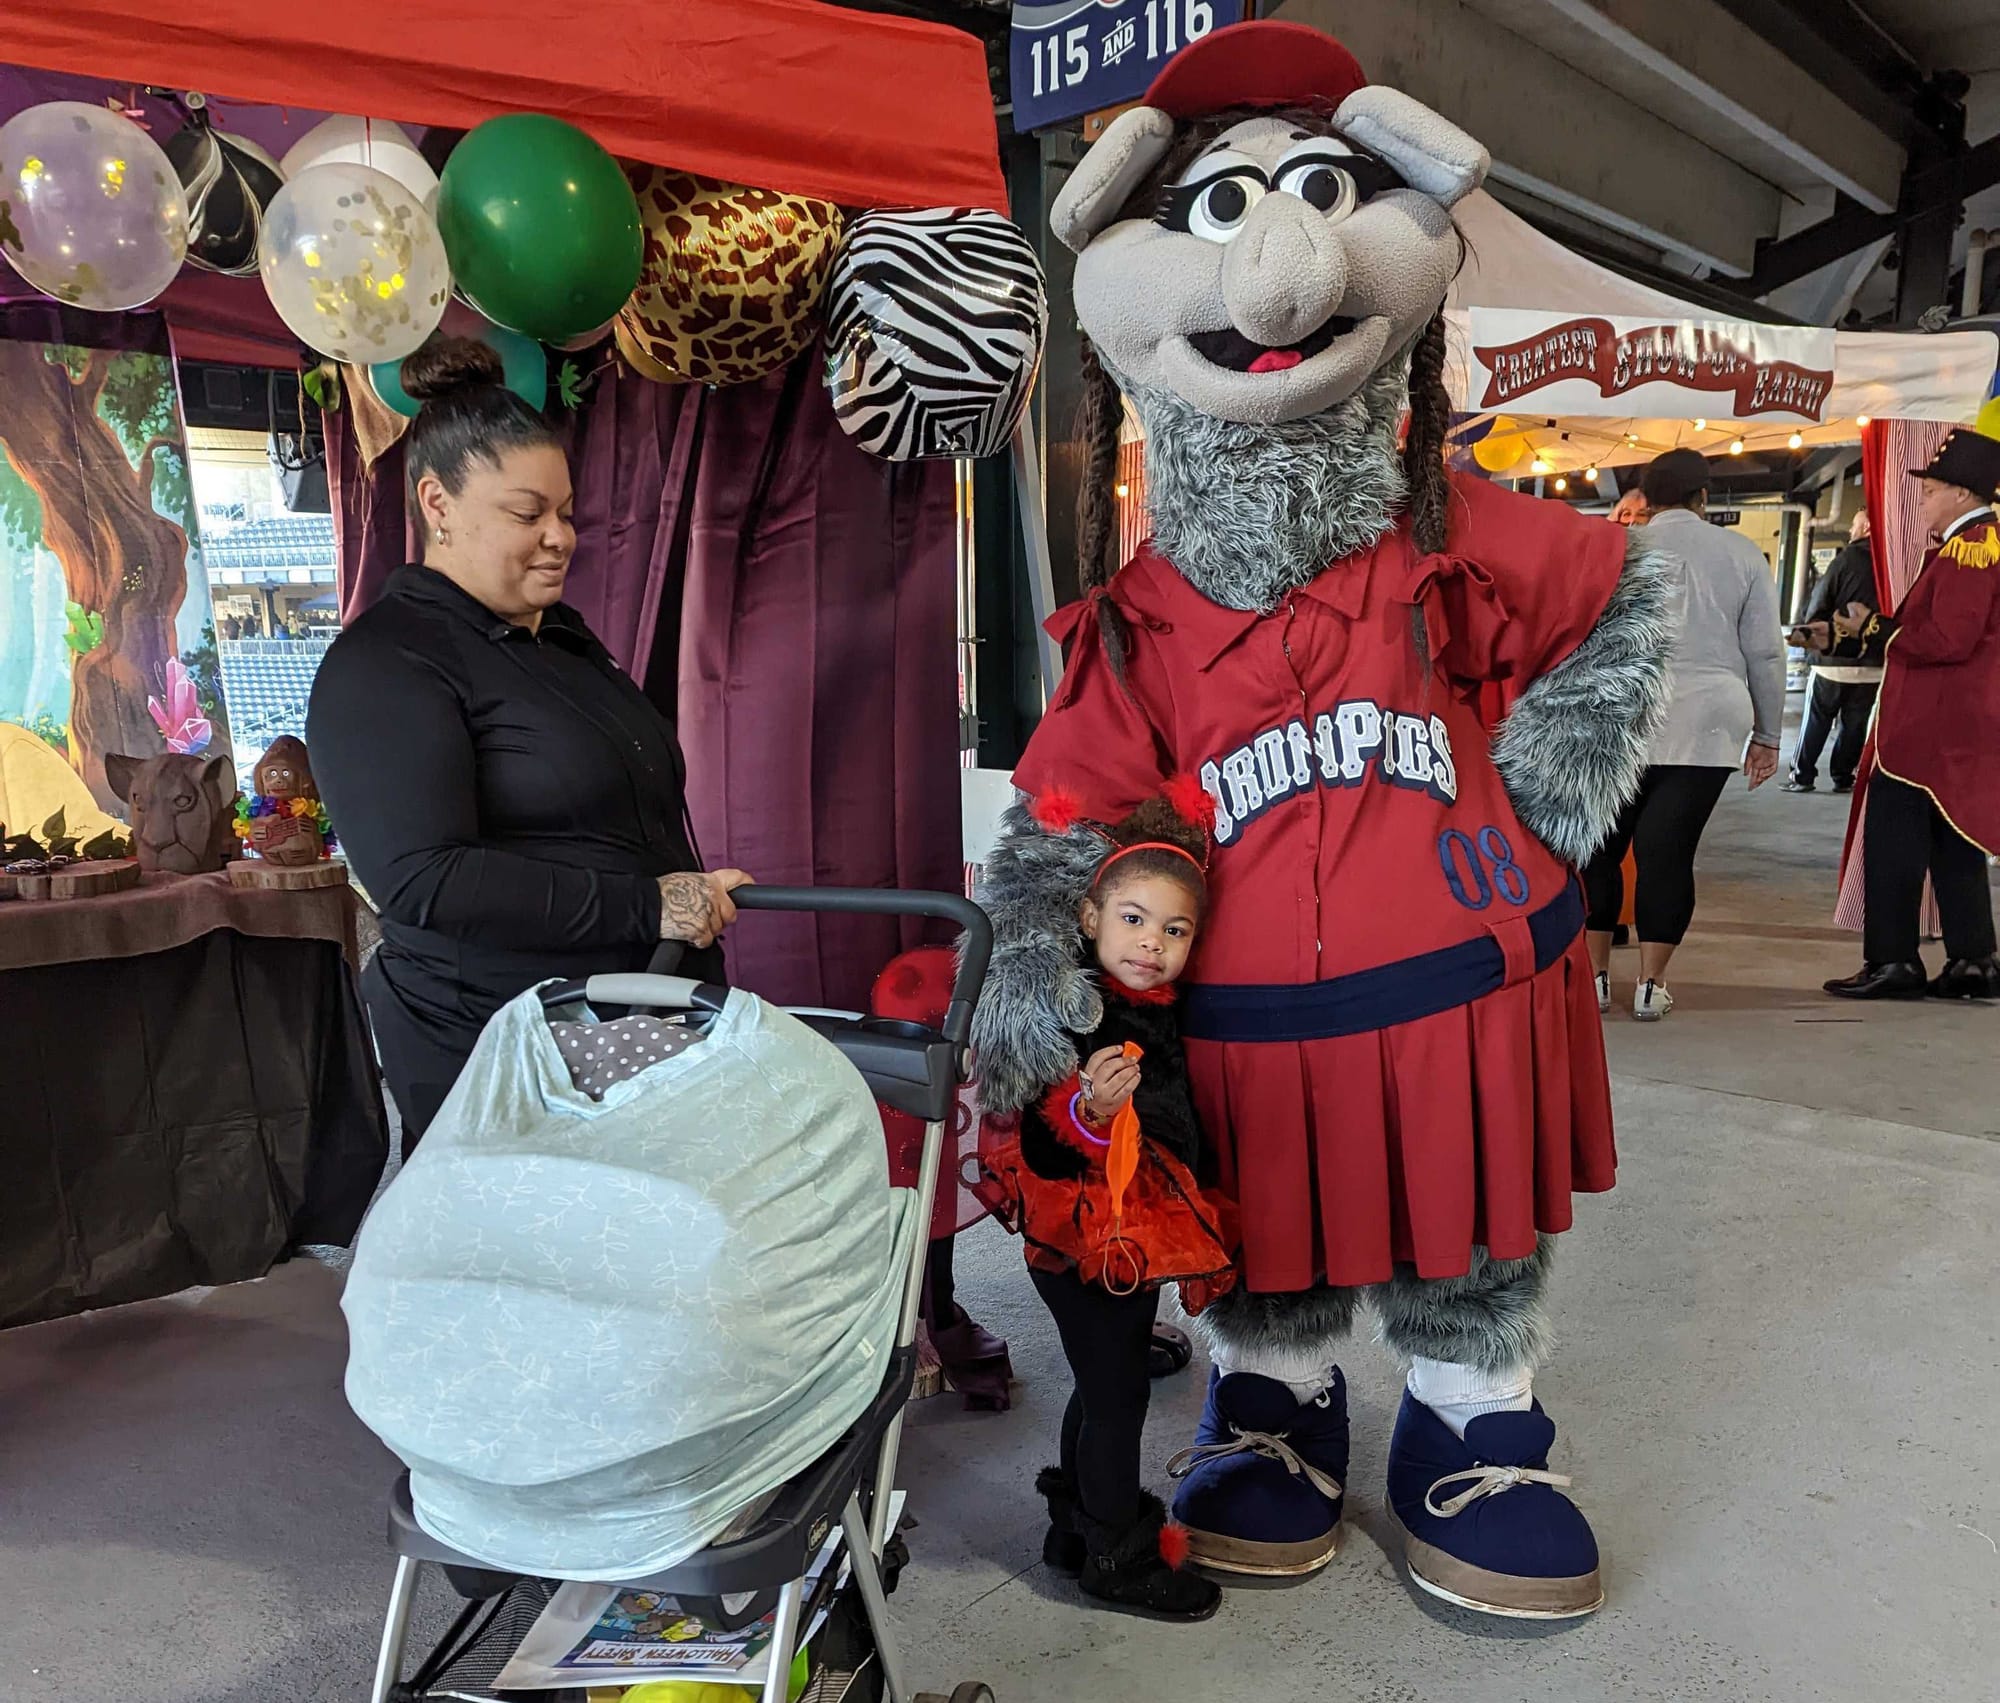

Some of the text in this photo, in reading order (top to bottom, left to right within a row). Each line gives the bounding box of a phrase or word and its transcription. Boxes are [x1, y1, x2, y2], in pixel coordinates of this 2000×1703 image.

[1031, 0, 1214, 97] 115 AND 116
[1494, 326, 1598, 398] GREATEST
[1750, 367, 1824, 414] EARTH
[1200, 699, 1458, 846] IRONPIGS
[1437, 825, 1530, 911] 08
[579, 1646, 739, 1662] HALLOWEEN SAFETY
